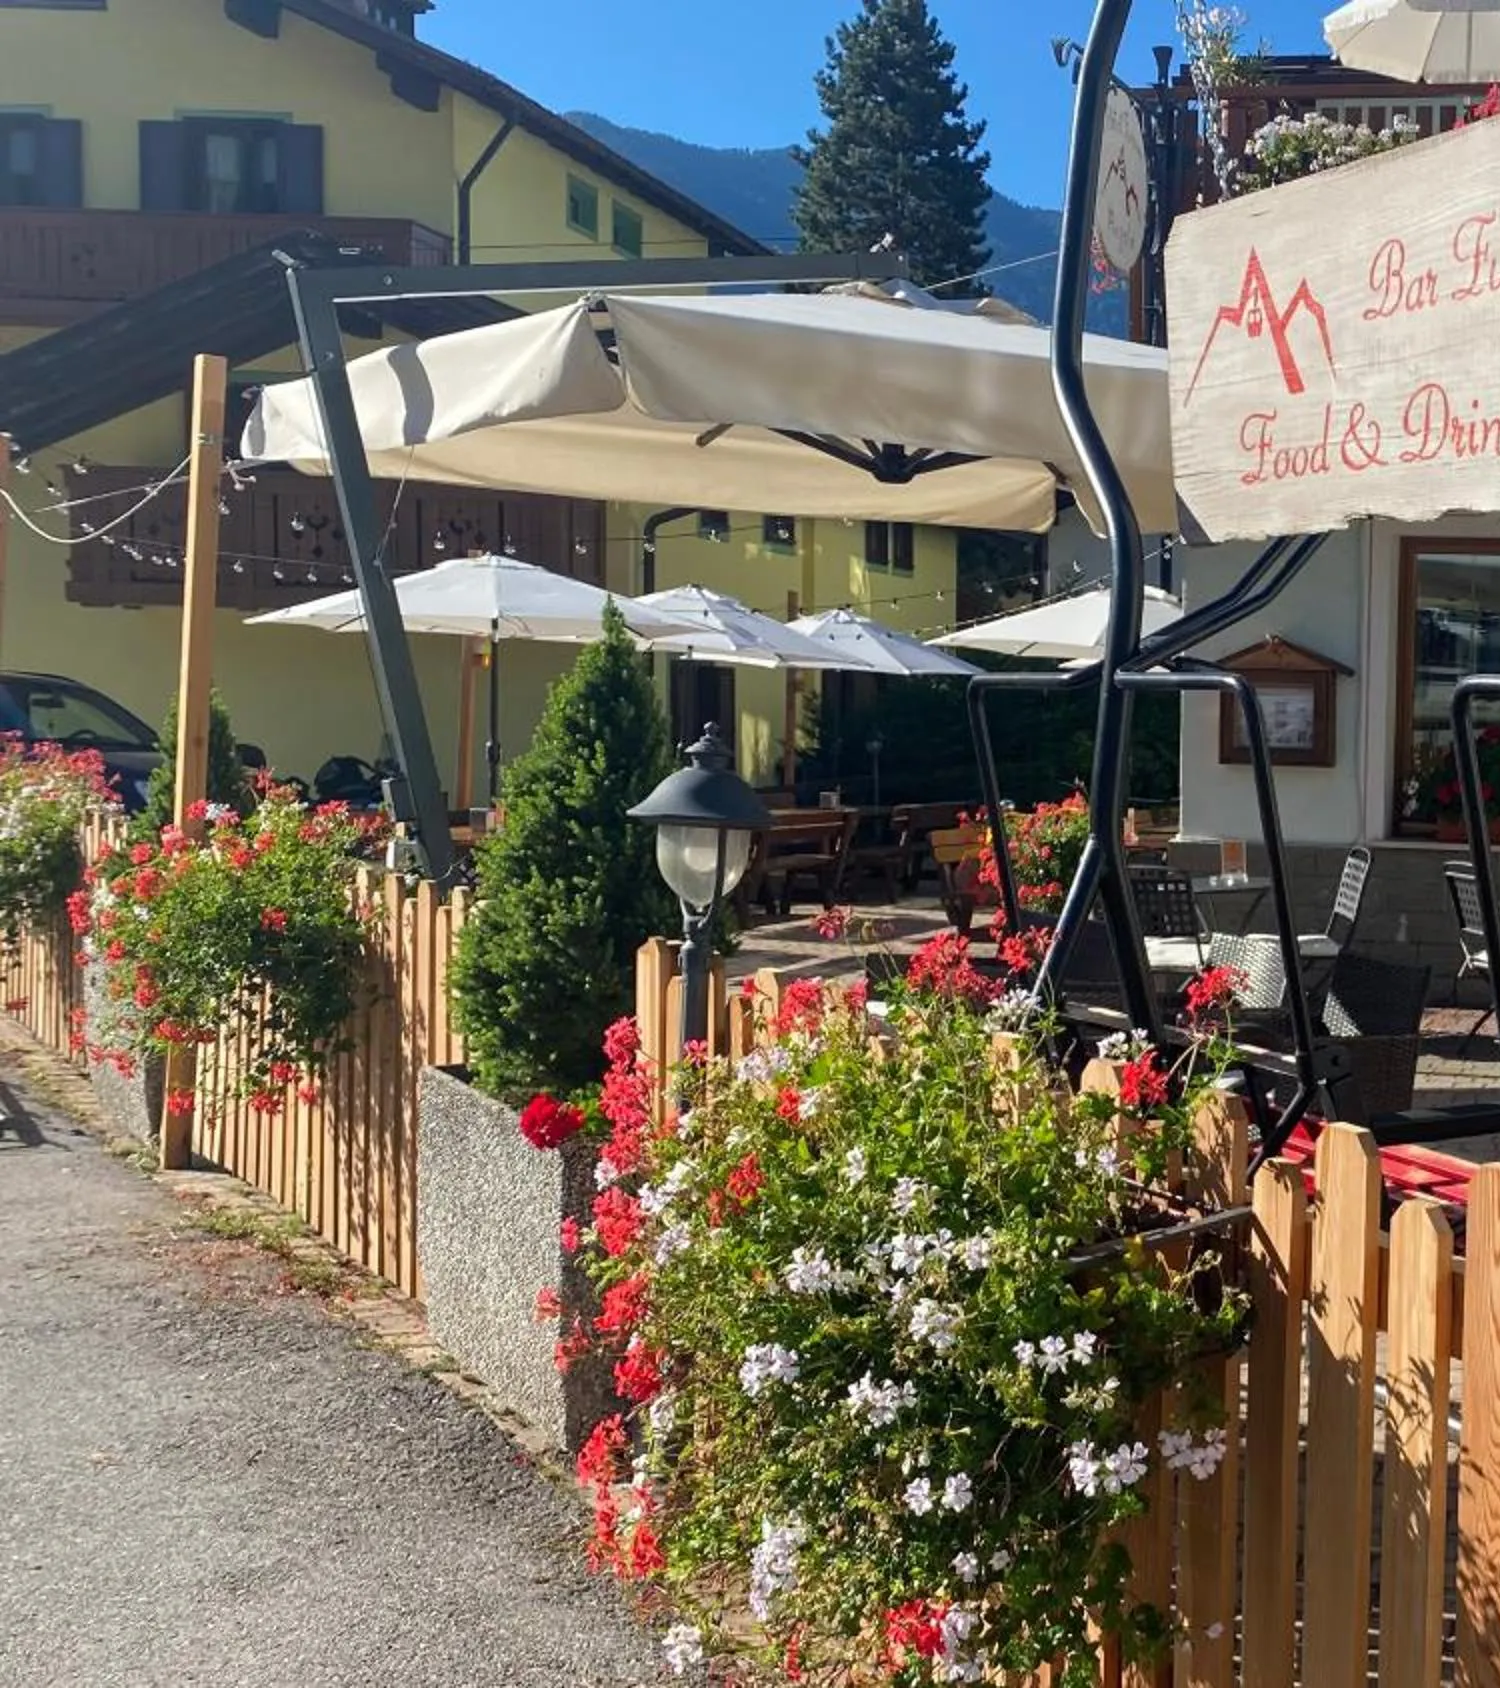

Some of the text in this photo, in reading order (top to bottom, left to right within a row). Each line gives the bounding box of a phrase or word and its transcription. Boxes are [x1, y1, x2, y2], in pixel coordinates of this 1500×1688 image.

[1363, 238, 1439, 320] Bar
[1239, 402, 1331, 484] Food
[1340, 402, 1389, 471] &
